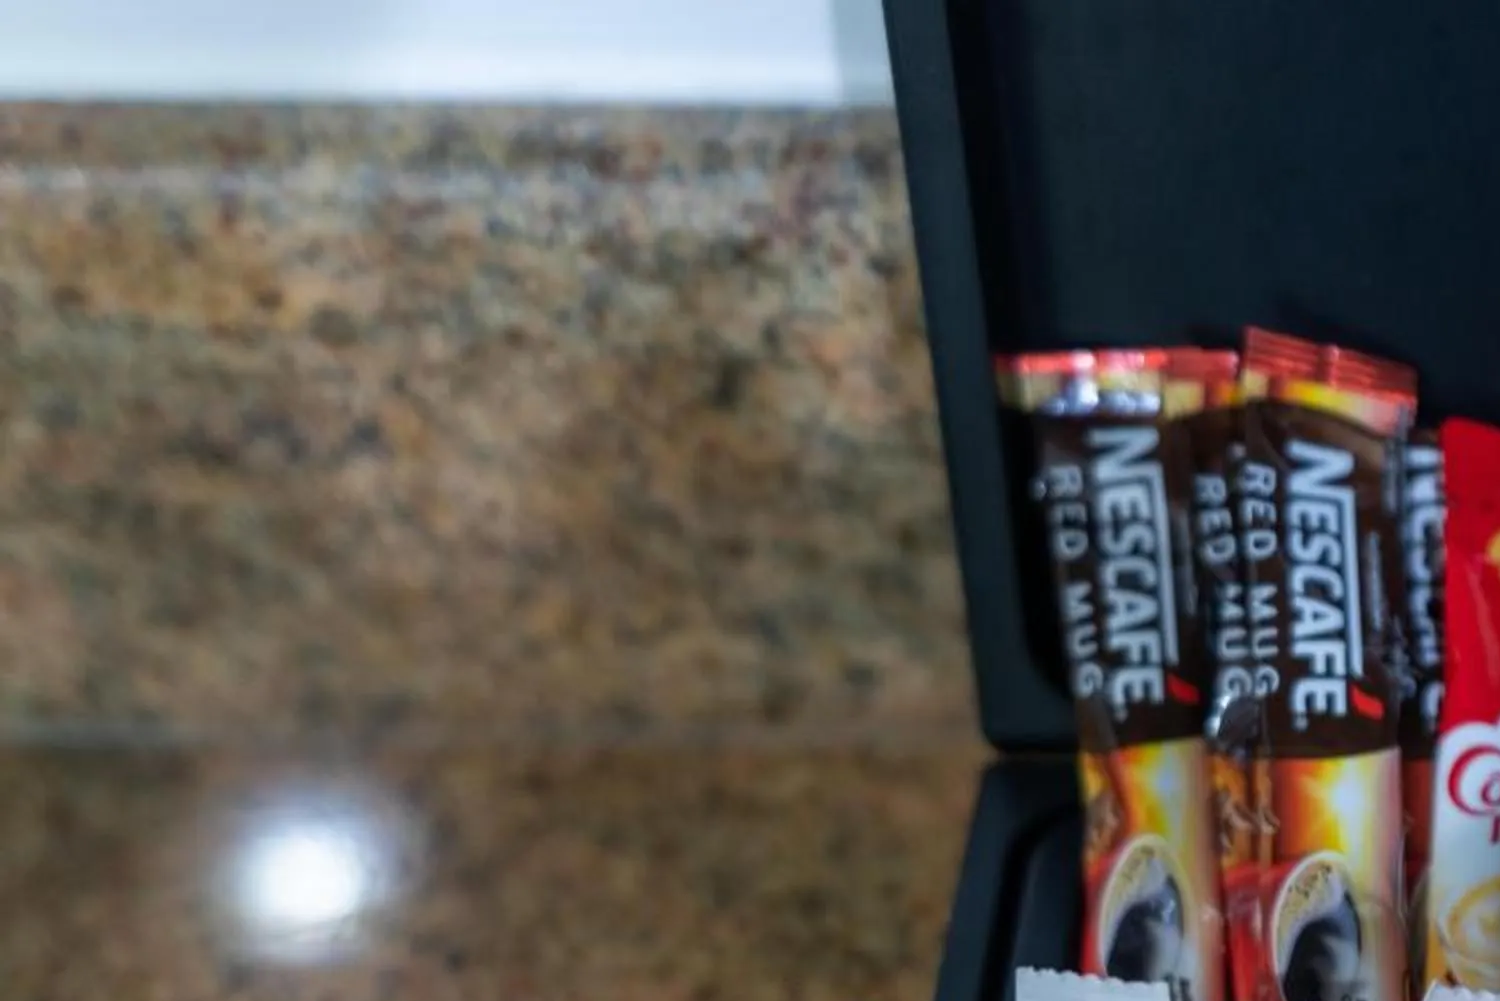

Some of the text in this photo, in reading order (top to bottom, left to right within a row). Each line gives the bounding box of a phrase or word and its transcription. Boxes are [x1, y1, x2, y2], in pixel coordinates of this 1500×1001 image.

[1046, 463, 1102, 698] RED MUG
[1195, 473, 1238, 566] RED
[1238, 462, 1280, 697] RED MUG
